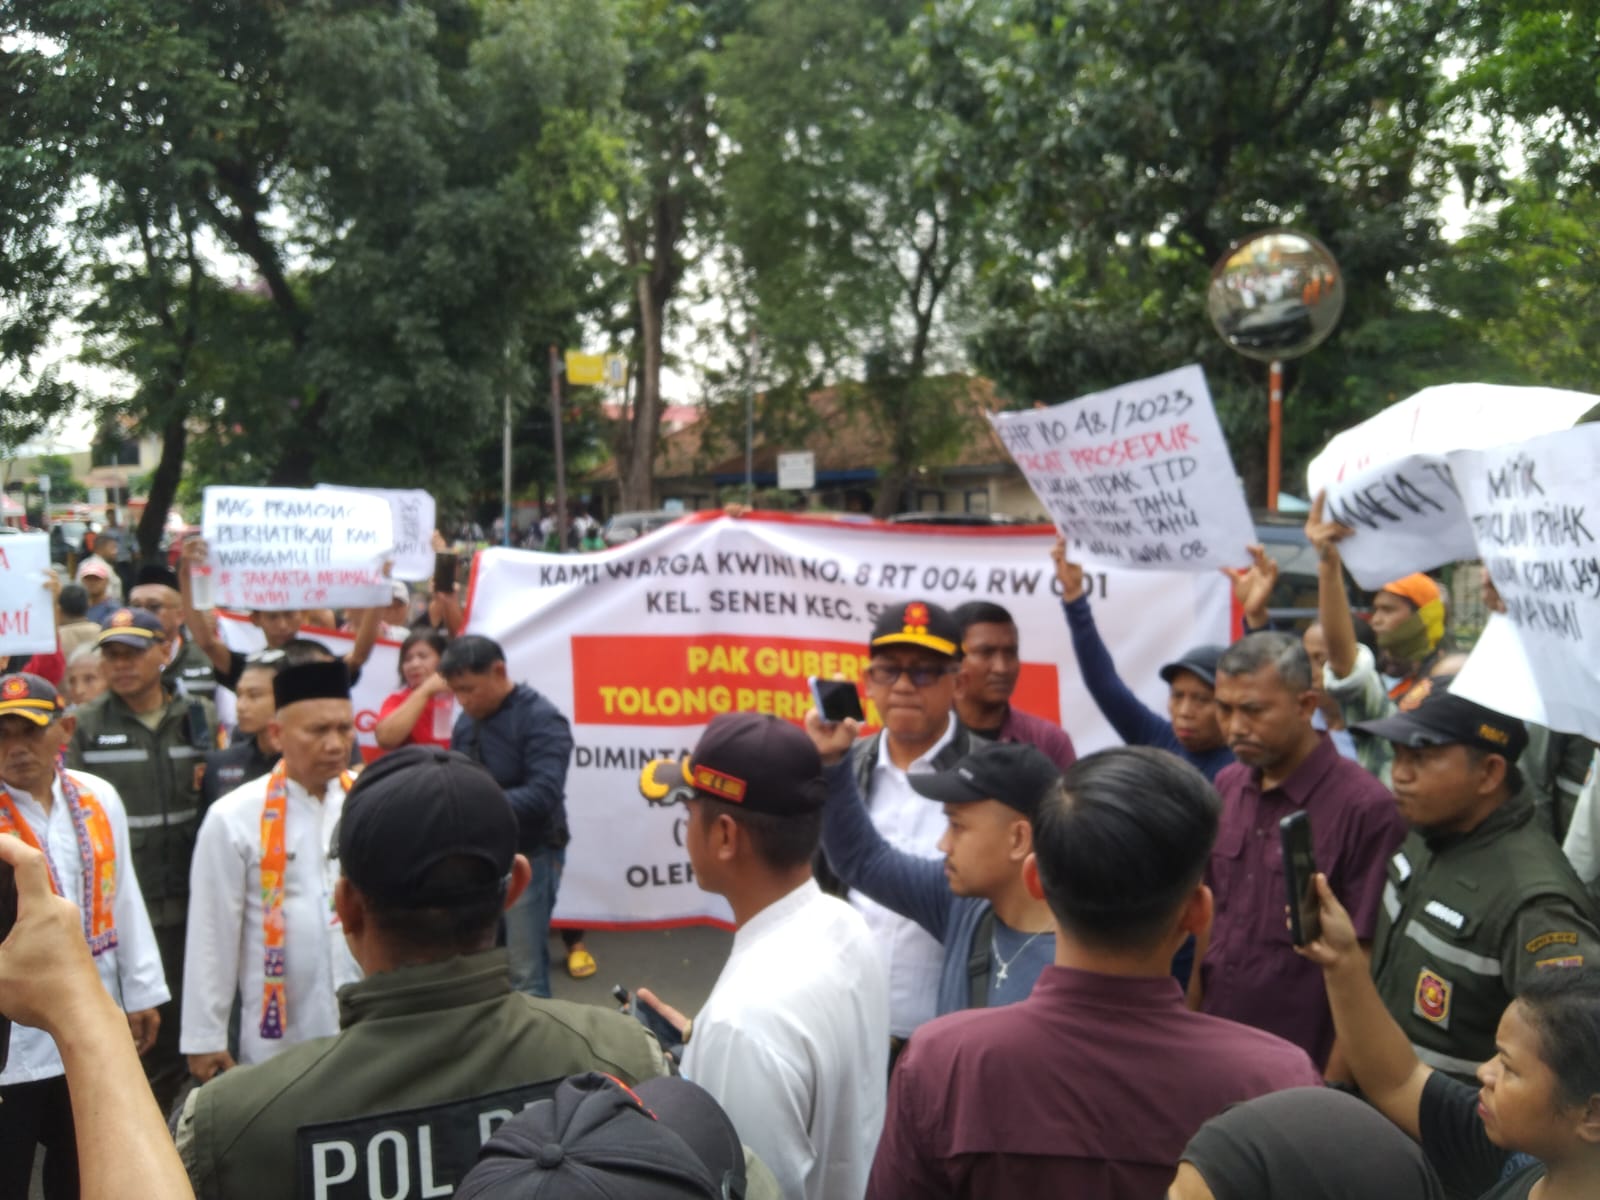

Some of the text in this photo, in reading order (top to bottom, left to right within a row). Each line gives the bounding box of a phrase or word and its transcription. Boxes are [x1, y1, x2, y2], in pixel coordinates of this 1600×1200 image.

[1074, 389, 1194, 438] 48/2023
[1069, 422, 1201, 473] PROSEDUR
[1084, 470, 1143, 497] TIDAK
[1141, 456, 1198, 487] TTD
[217, 497, 255, 518] MAS
[1128, 486, 1189, 518] TAHU
[217, 524, 378, 544] PERHATIKAN KAM
[1142, 508, 1200, 537] TAHU
[241, 569, 311, 588] JAKARTA
[541, 563, 598, 587] KAMI
[605, 552, 709, 579] WARGA
[717, 551, 796, 578] KWINI
[802, 555, 846, 584] NO.
[854, 563, 873, 587] 8
[878, 563, 918, 590] RT
[921, 566, 978, 592] 004
[986, 569, 1043, 595] RW
[1570, 557, 1600, 600] JAY
[646, 591, 701, 614] KEL.
[708, 590, 798, 616] SENEN
[806, 595, 861, 622] KEC.
[686, 645, 750, 677] PAK
[599, 686, 733, 716] TOLONG
[312, 1125, 454, 1200] POL
